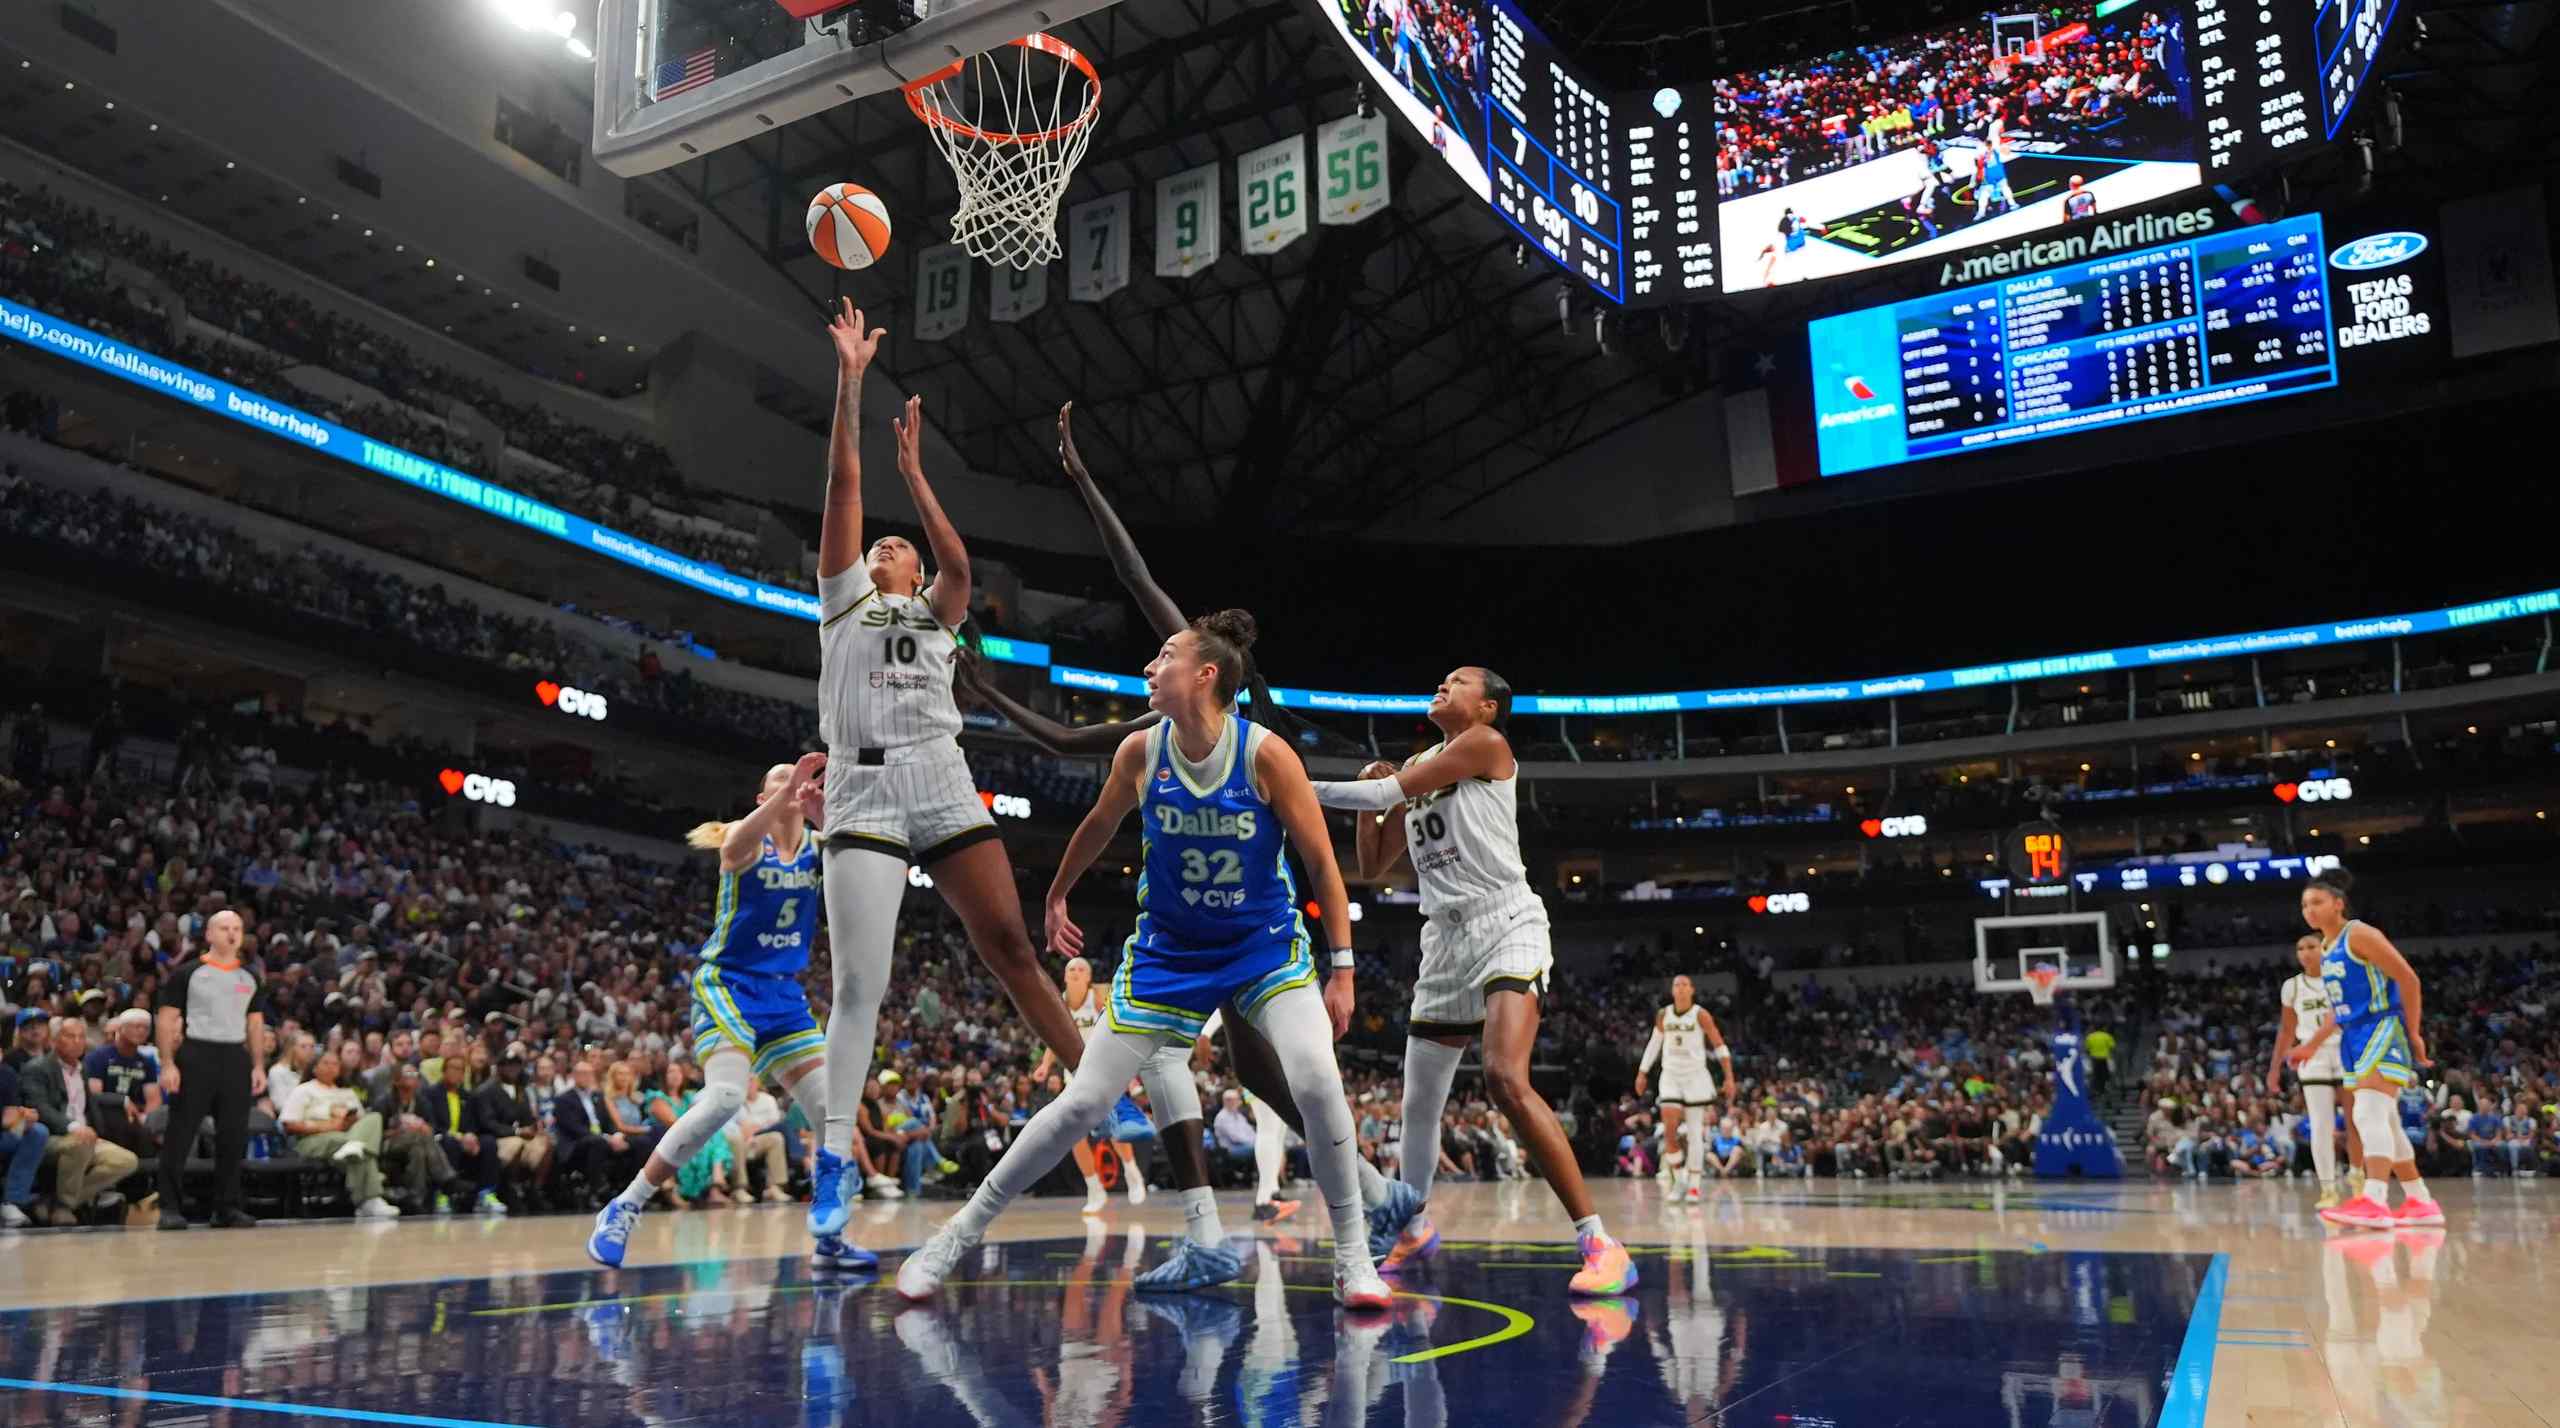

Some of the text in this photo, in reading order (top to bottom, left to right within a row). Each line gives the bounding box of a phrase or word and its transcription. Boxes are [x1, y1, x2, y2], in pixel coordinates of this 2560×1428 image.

[2205, 90, 2224, 107] FT
[2208, 117, 2229, 133] FG
[1512, 127, 1527, 166] 7
[2211, 152, 2230, 168] FT
[1327, 141, 1379, 199] 56
[1249, 169, 1296, 230] 26
[1571, 183, 1598, 225] 10
[1176, 199, 1198, 250] 9
[1533, 196, 1570, 246] 6:01
[1089, 224, 1109, 272] 7
[1940, 207, 2214, 287] American Airlines
[2248, 242, 2271, 254] DAL
[927, 265, 961, 314] 19
[2006, 275, 2053, 295] DALLAS
[2347, 274, 2413, 304] TEXAS
[2354, 296, 2410, 325] FORD
[2338, 312, 2431, 349] DEALERS
[2013, 347, 2070, 367] CHICAGO
[228, 391, 330, 446] betterhelp
[1820, 403, 1897, 428] American
[362, 440, 439, 488] THERAPY:
[440, 470, 482, 504] YOUR
[482, 485, 514, 515] 6TH
[2448, 592, 2559, 626] THERAPY: YOUR
[2334, 618, 2413, 639] betterhelp
[884, 635, 917, 664] 10
[886, 671, 930, 682] UChicago
[886, 680, 928, 690] Medicine
[1062, 670, 1120, 692] betterhelp
[1861, 677, 1926, 696] betterhelp
[557, 686, 608, 721] CVS
[462, 773, 517, 808] CVS
[1222, 788, 1250, 799] Albert
[2297, 777, 2352, 802] CVS
[992, 793, 1032, 819] CVS
[1155, 805, 1257, 841] Dallas
[1412, 812, 1446, 847] 30
[1880, 814, 1927, 837] CVS
[1180, 849, 1244, 884] 32
[2032, 850, 2061, 879] 14
[1203, 888, 1247, 908] CVS
[1766, 892, 1810, 914] CVS
[775, 898, 800, 929] 5
